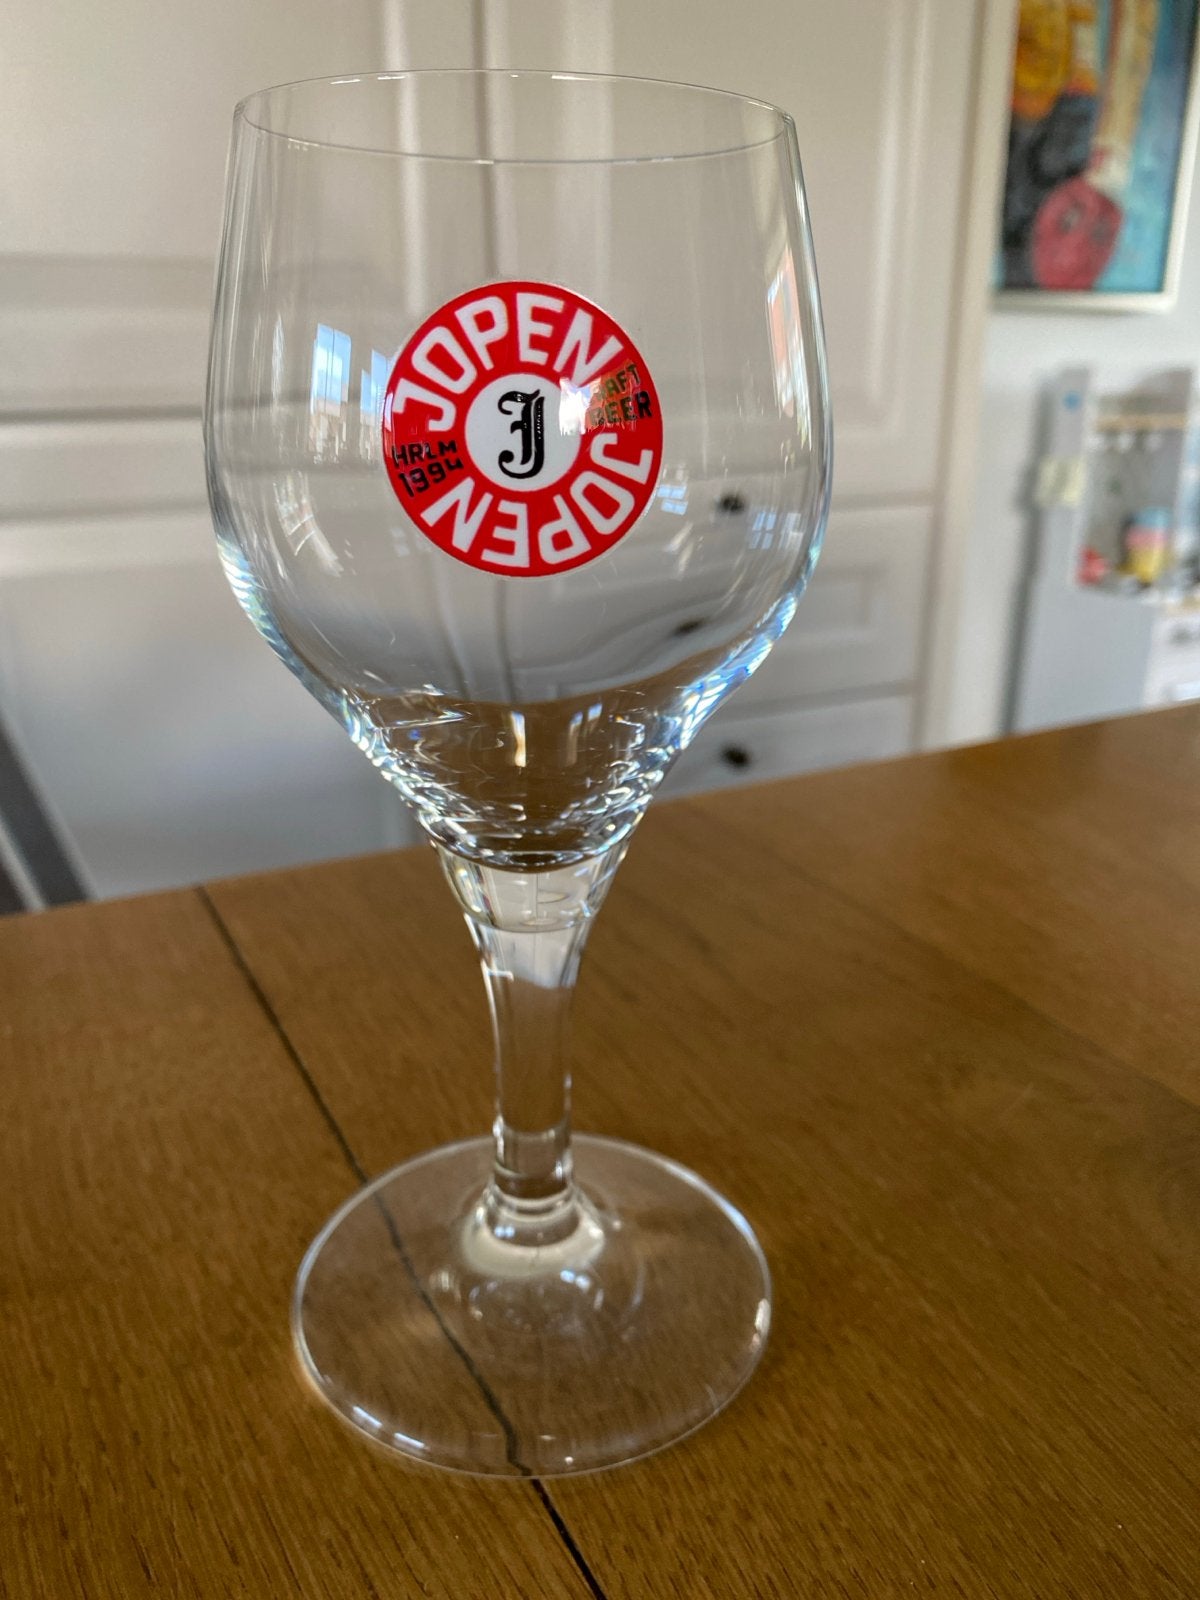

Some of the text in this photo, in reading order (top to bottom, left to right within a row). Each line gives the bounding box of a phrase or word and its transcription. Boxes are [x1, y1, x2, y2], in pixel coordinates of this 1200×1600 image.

[392, 292, 624, 432] JOPEN
[590, 363, 640, 400] AFT
[589, 390, 652, 426] BEER
[391, 440, 457, 469] HRLM
[398, 457, 464, 497] 1994
[420, 432, 654, 568] JOPEN
